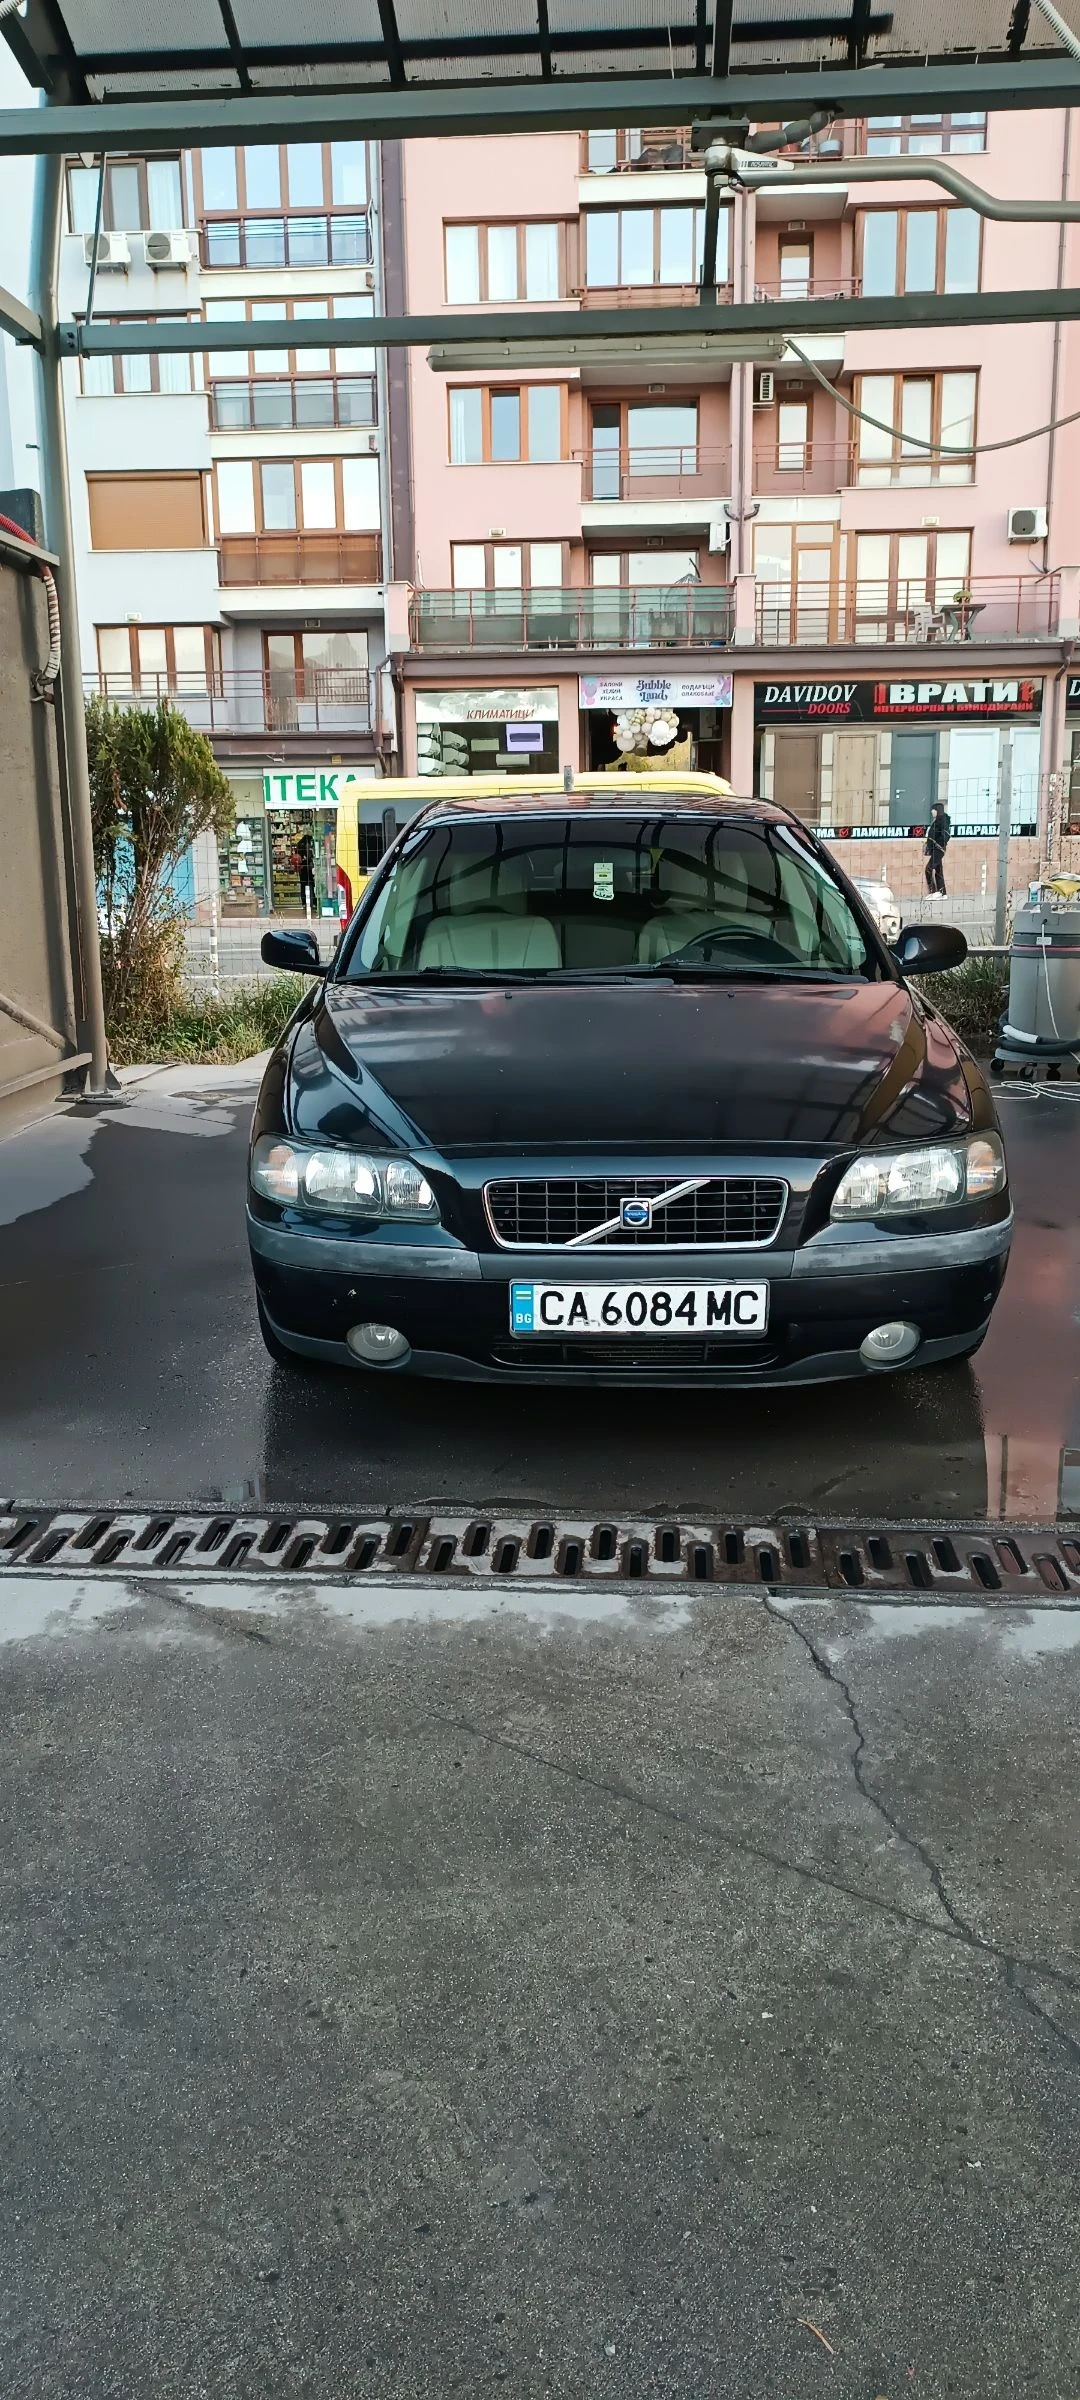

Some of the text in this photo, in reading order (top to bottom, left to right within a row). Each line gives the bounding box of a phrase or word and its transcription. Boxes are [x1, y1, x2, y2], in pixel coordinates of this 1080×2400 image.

[636, 680, 671, 691] Bubble
[639, 690, 668, 702] Land
[764, 685, 857, 703] DAVIDOV
[890, 682, 1018, 704] ВРАТИ
[807, 703, 851, 714] DOORS
[466, 709, 535, 720] КЛИМАТИЦИ
[851, 827, 910, 838] ЛАМИНАТ
[540, 1290, 758, 1326] CA 6084 MC
[516, 1313, 532, 1324] BG
